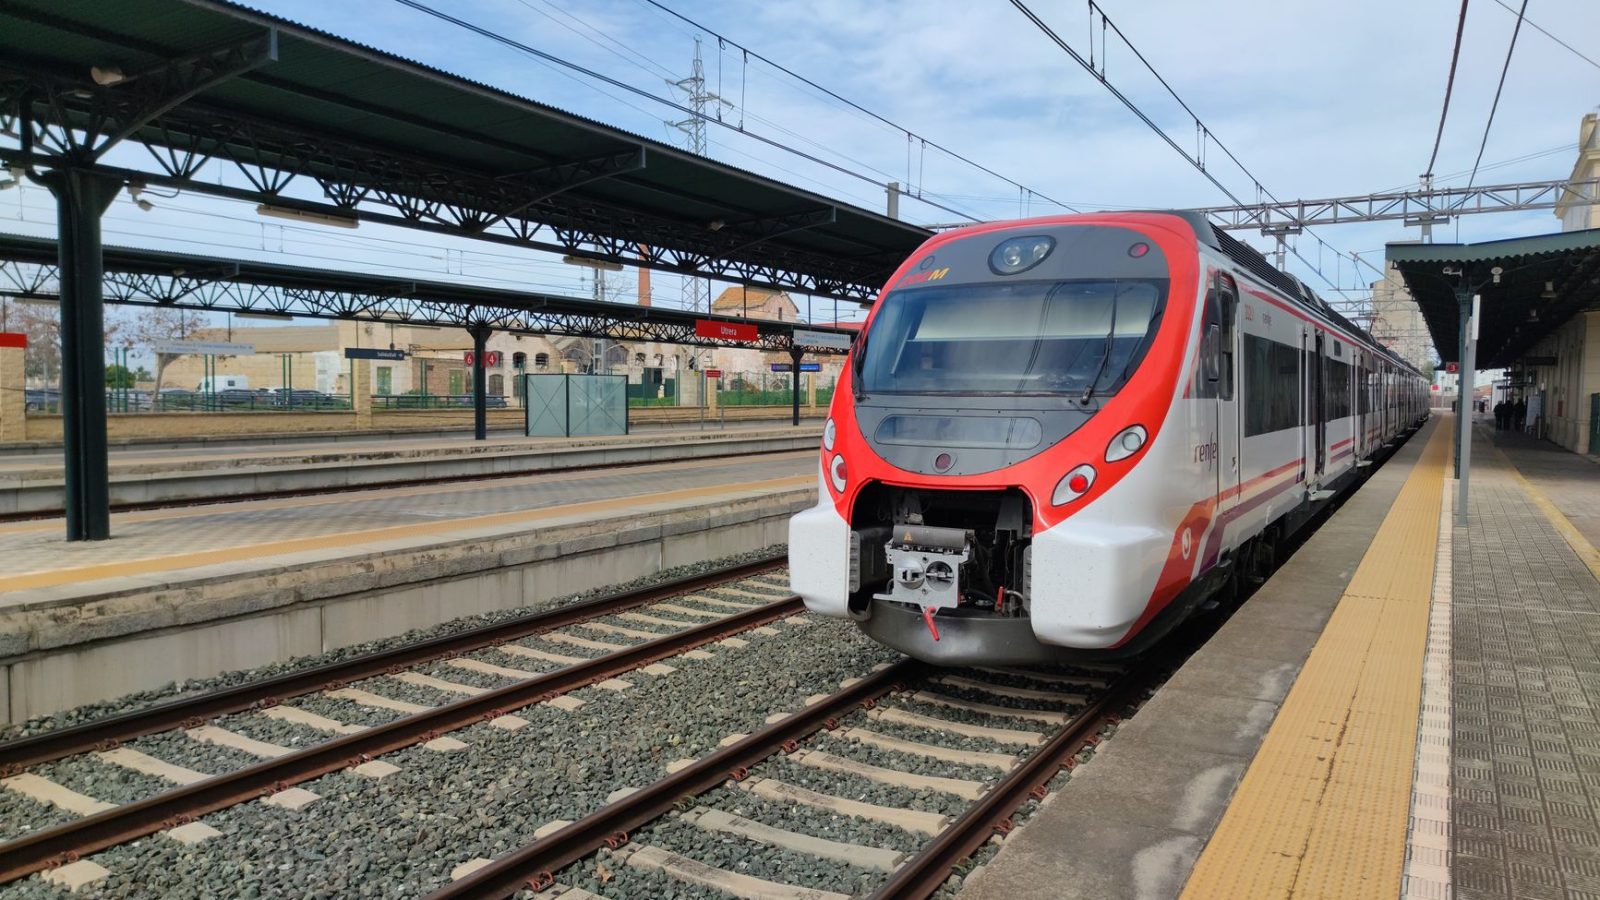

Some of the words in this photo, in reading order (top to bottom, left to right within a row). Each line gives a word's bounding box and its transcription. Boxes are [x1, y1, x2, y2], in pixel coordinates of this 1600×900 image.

[720, 325, 737, 336] Utrera
[467, 354, 472, 364] 6
[489, 354, 495, 364] 4
[1194, 431, 1216, 472] renfe
